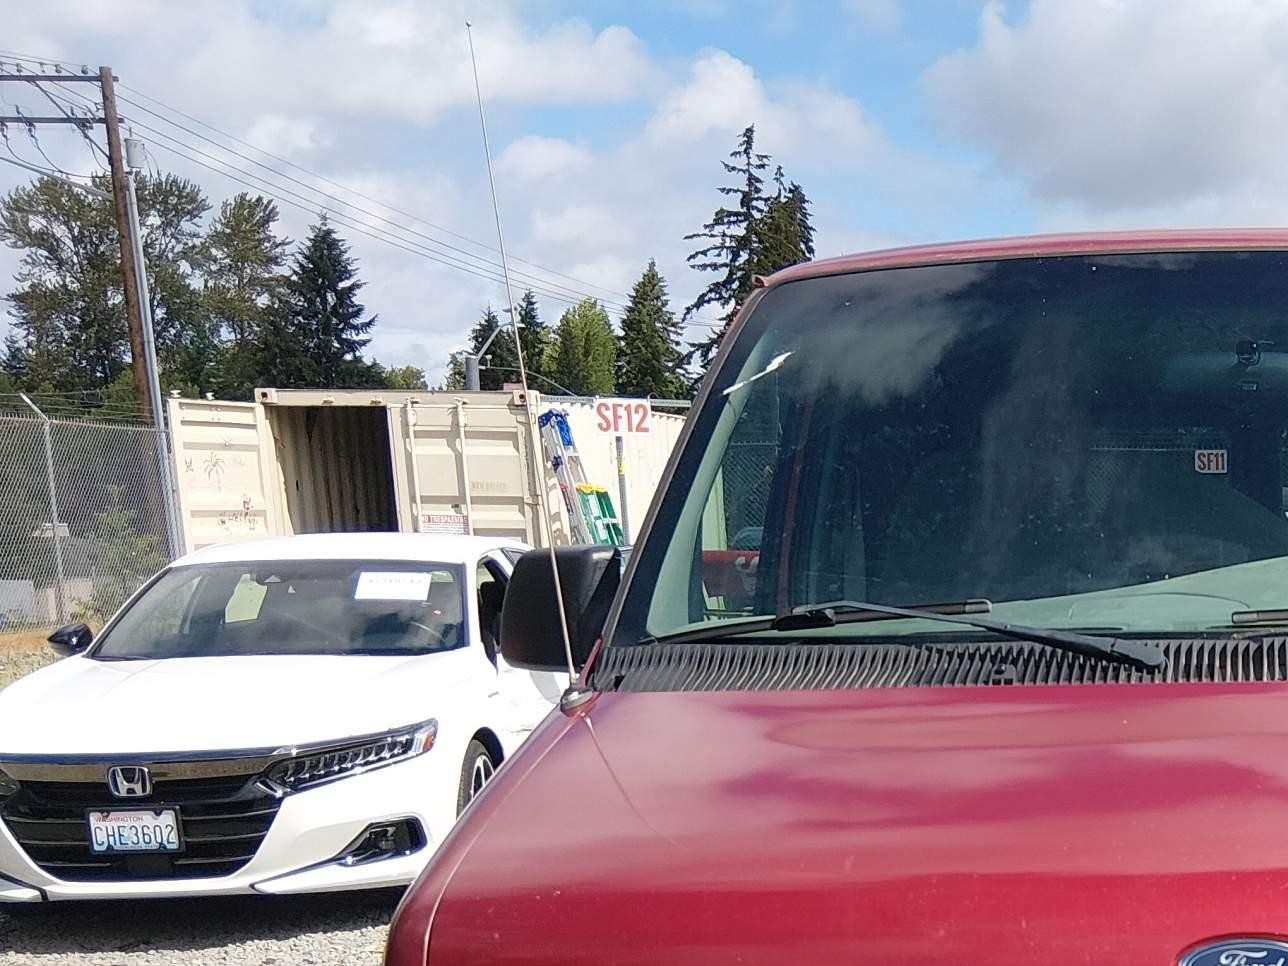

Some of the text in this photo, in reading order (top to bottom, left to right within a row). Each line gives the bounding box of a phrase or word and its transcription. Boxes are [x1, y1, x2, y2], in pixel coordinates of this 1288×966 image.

[596, 402, 650, 433] SF12
[1197, 452, 1225, 471] SF11
[94, 824, 177, 847] CHE3602
